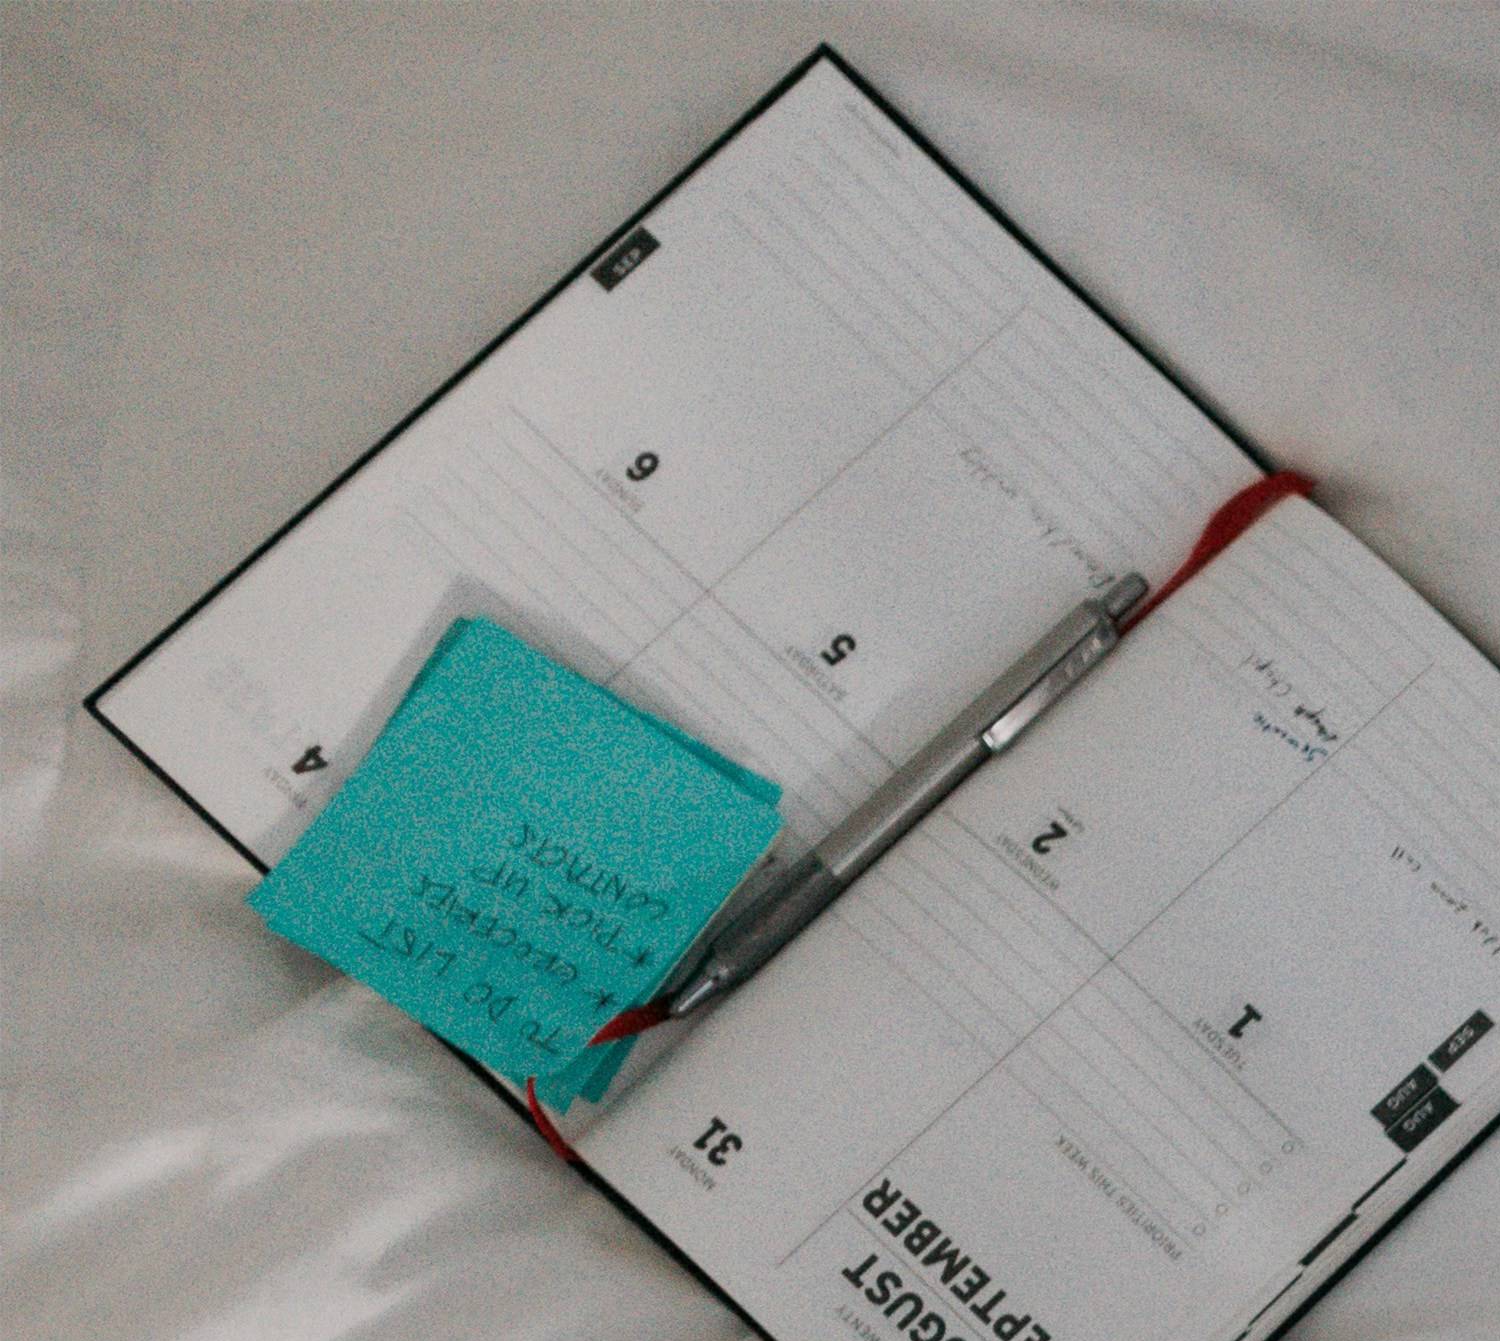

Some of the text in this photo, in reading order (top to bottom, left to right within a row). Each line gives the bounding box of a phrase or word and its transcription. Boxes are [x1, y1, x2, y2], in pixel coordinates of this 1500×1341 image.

[619, 442, 667, 491] 6
[814, 623, 861, 672] 5
[286, 737, 336, 788] 4
[992, 828, 1063, 895] WEDNESDAY
[1026, 816, 1070, 860] 2
[466, 847, 629, 957] PICK UP
[504, 811, 671, 940] CONTACTS
[406, 866, 582, 995] GROCERIES
[355, 902, 573, 1060] TO DO LIST
[1189, 1013, 1251, 1073] TUESDAY
[1221, 999, 1265, 1044] 1
[1443, 1023, 1475, 1057] SEP
[1384, 1076, 1419, 1112] AUG
[1400, 1098, 1435, 1135] AUG
[664, 1141, 720, 1194] MONDAY
[687, 1112, 748, 1173] 31
[1051, 1131, 1187, 1263] PRIORITIES THIS WEEK
